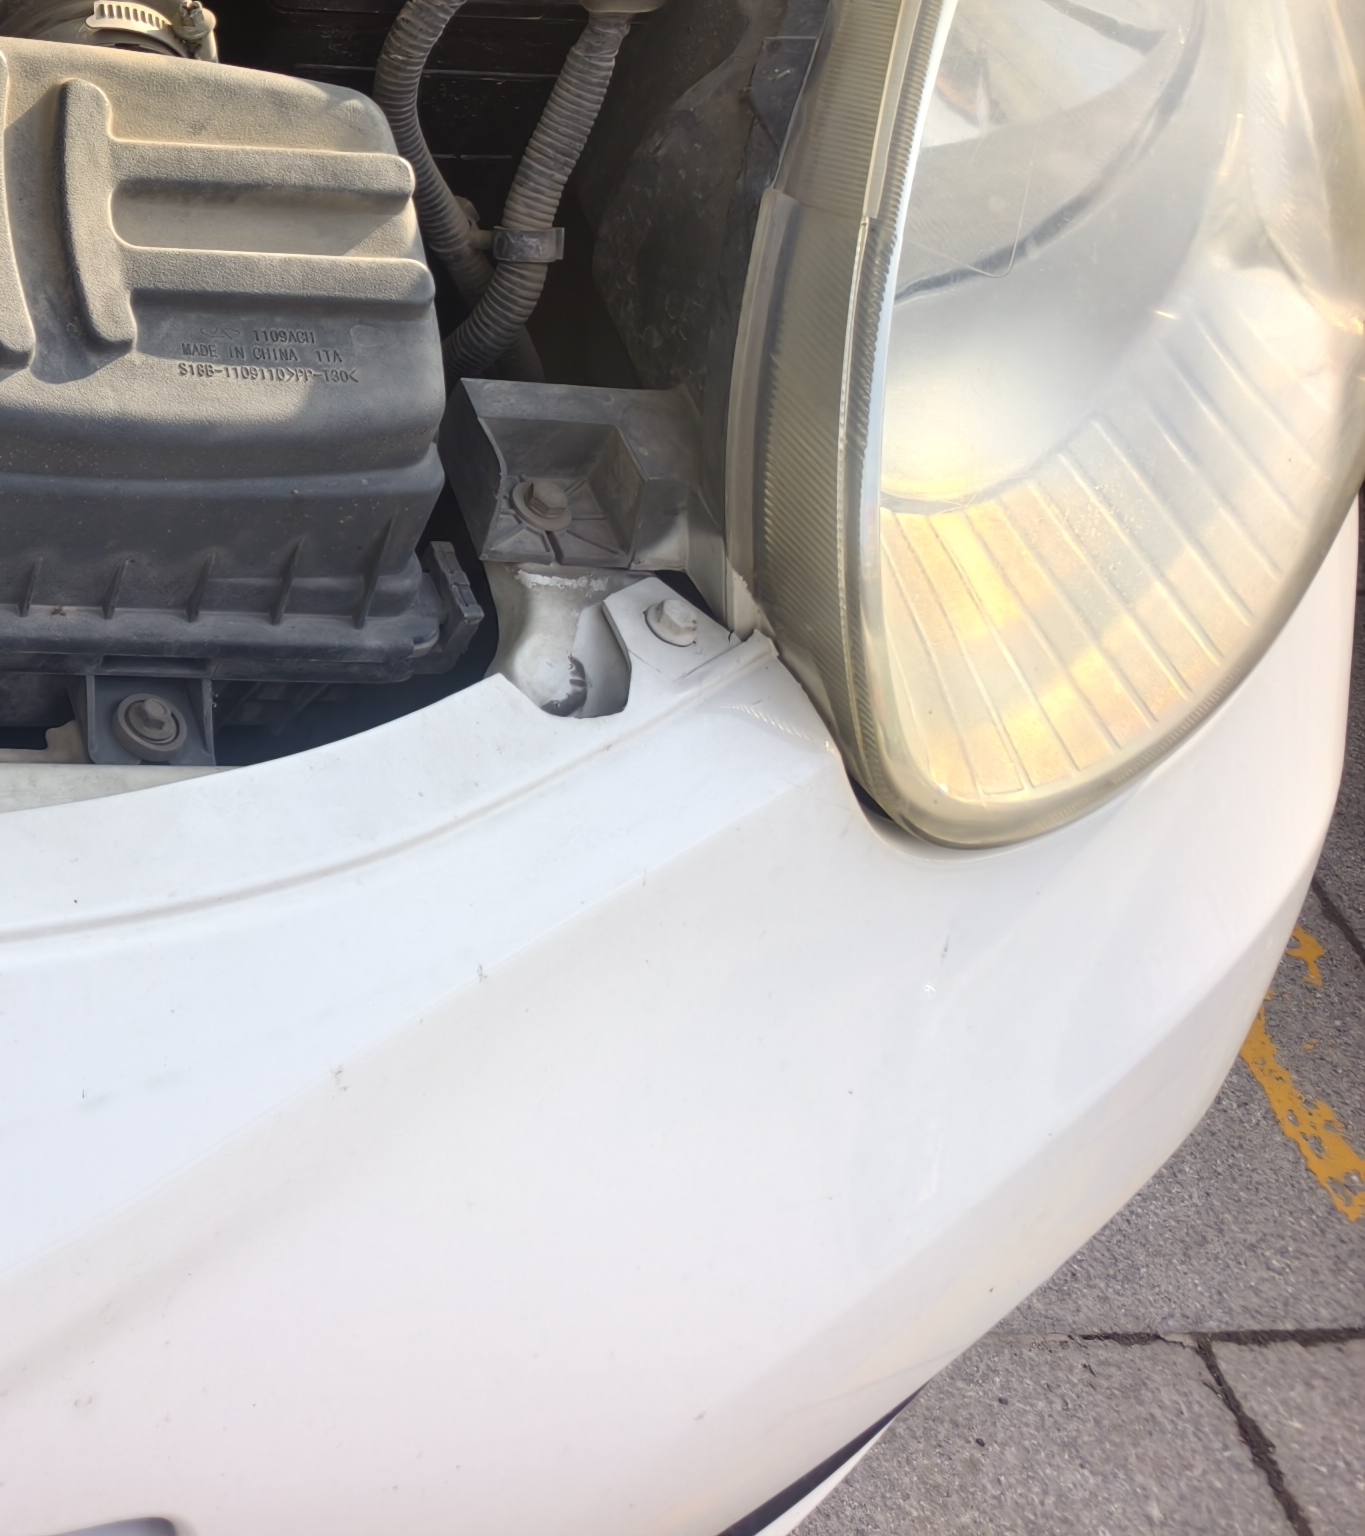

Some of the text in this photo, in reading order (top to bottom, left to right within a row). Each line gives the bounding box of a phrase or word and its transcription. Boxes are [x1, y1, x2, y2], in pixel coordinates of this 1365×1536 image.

[181, 342, 218, 358] MADE
[228, 345, 245, 360] IN
[252, 347, 299, 362] CHINA
